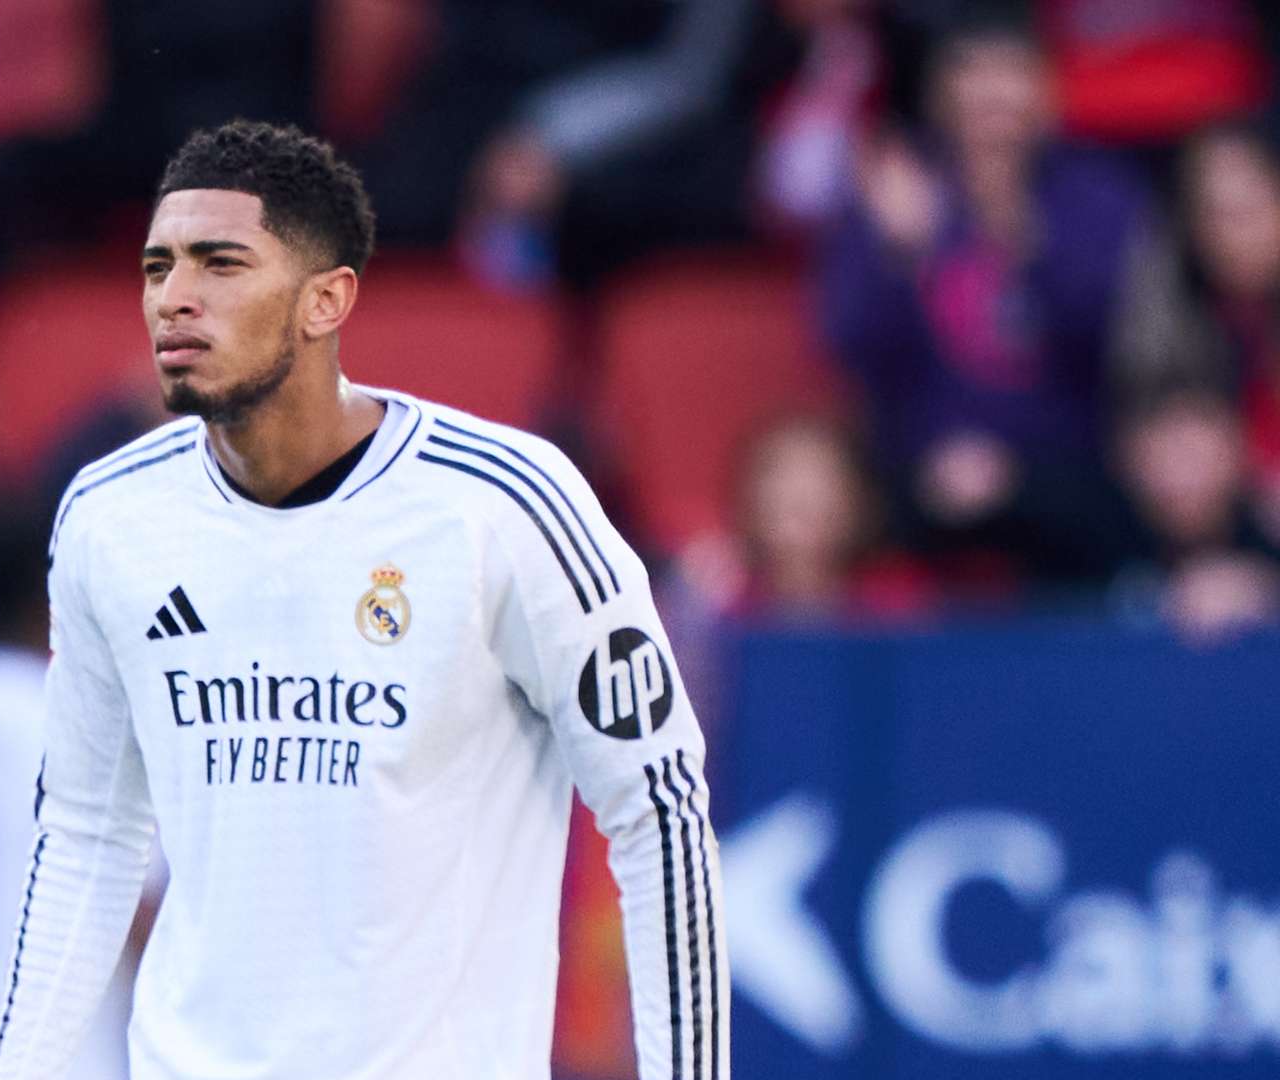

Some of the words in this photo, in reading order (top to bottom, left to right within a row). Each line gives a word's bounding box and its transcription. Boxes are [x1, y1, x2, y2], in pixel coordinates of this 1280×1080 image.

[163, 661, 408, 729] Emirates
[593, 628, 665, 740] hp
[250, 736, 360, 787] BETTER
